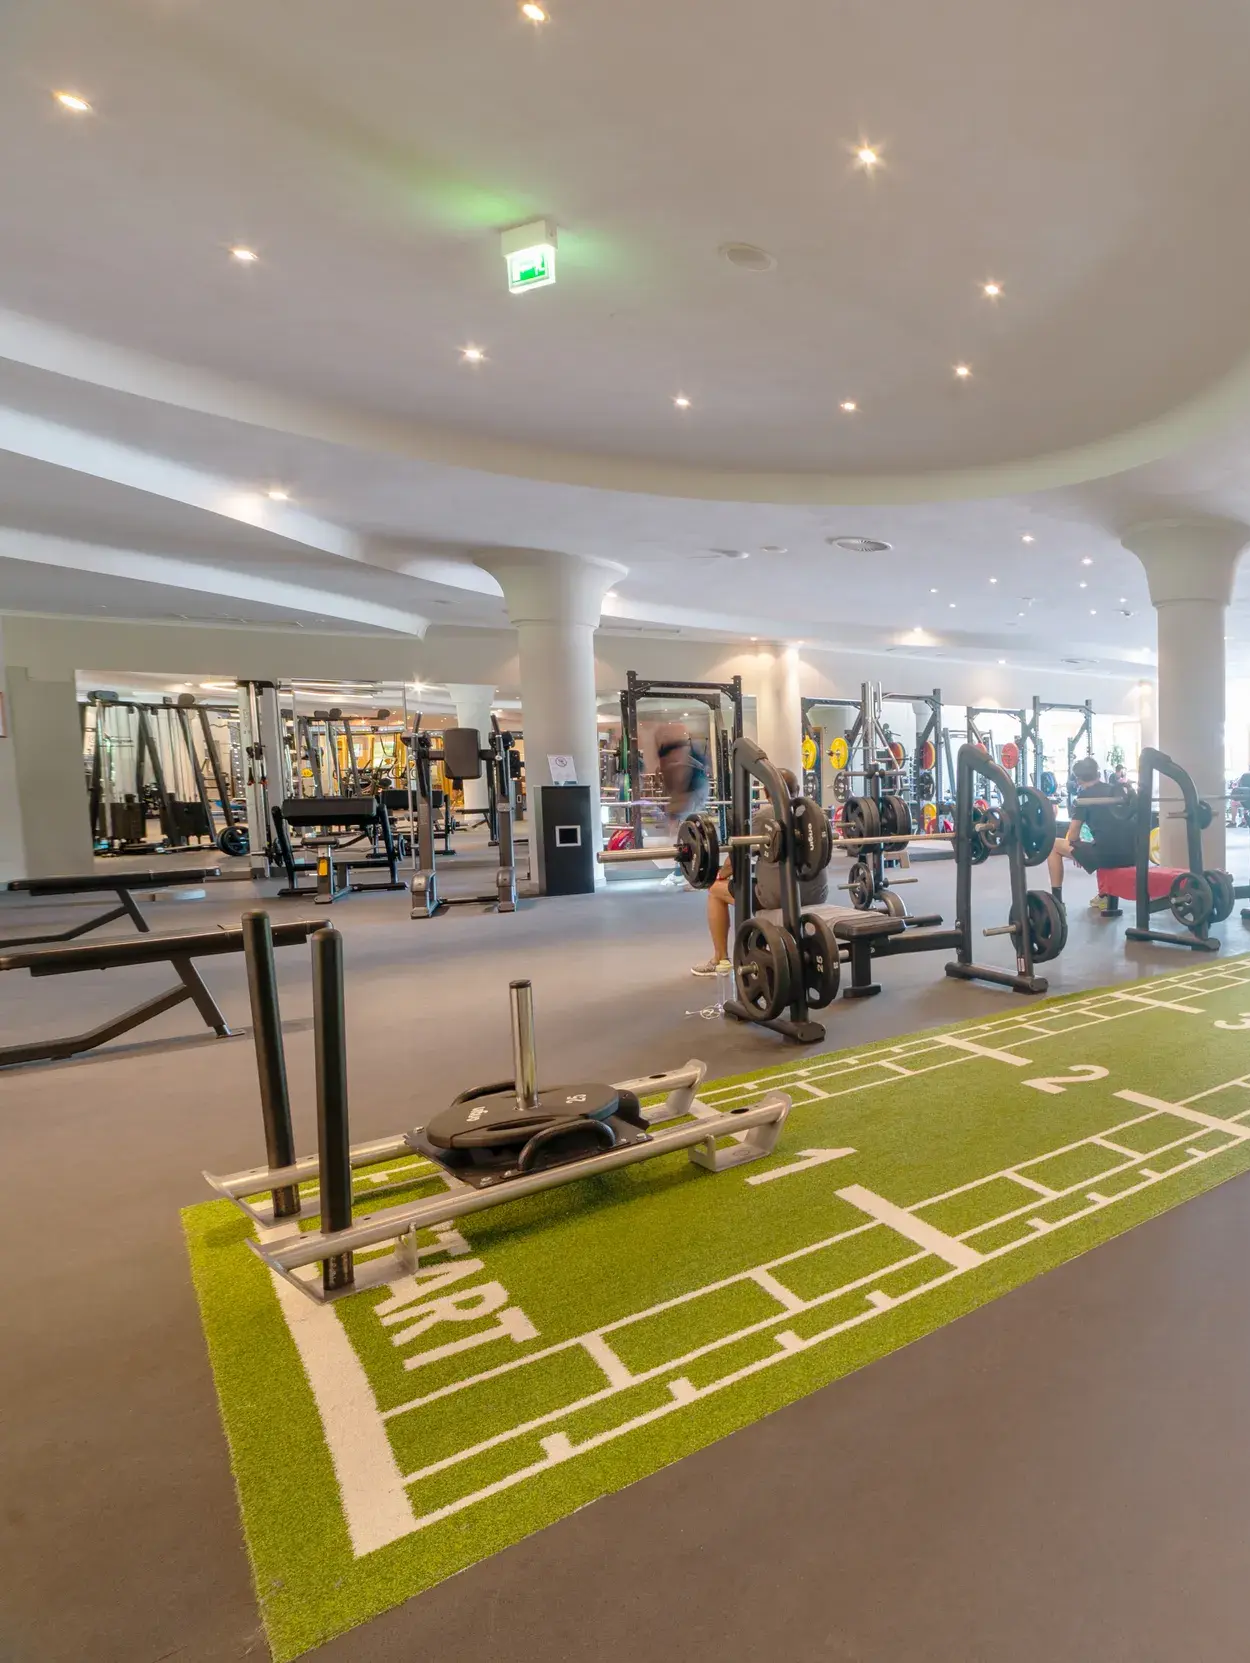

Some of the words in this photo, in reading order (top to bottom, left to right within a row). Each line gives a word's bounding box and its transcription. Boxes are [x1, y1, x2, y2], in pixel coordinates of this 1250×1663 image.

[816, 955, 824, 973] 25
[1020, 1064, 1110, 1095] 2
[744, 1147, 858, 1186] 1
[362, 1219, 542, 1372] TART
